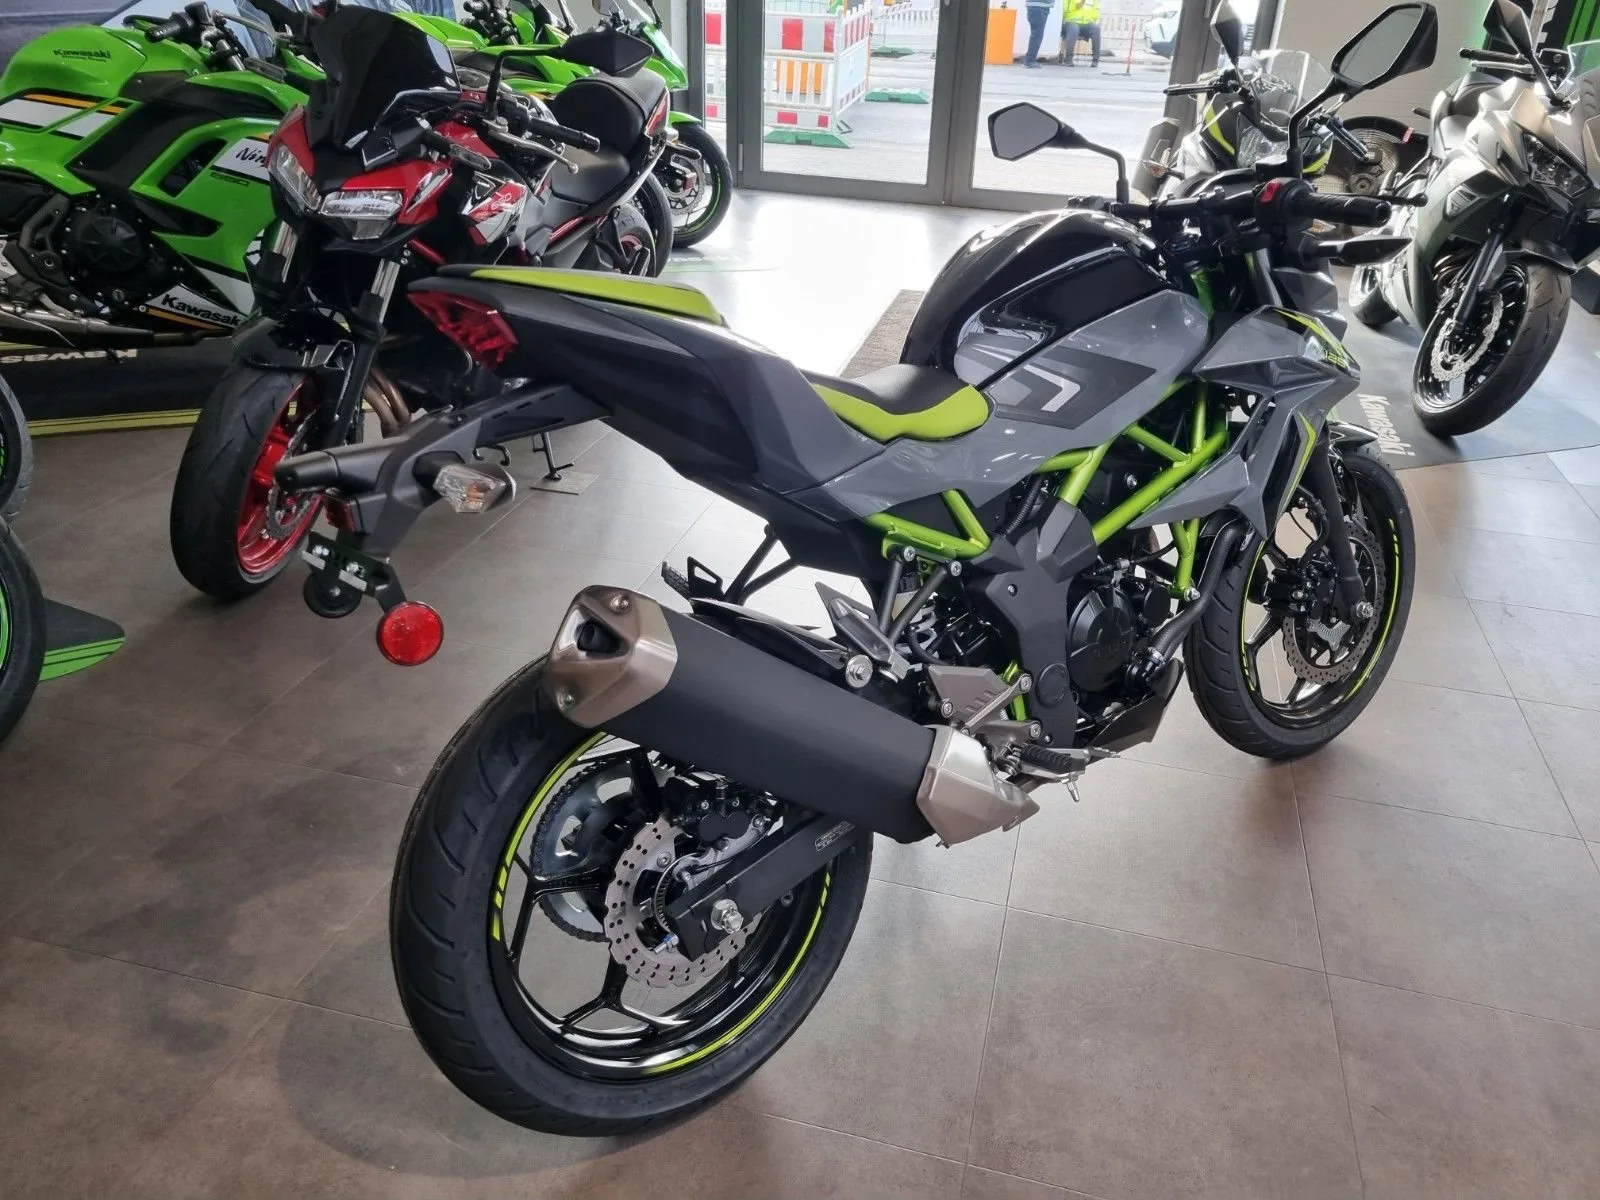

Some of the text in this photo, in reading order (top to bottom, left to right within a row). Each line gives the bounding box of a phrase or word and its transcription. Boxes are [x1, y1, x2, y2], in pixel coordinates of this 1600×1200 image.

[235, 147, 268, 168] Nin
[1325, 350, 1347, 368] 125
[1356, 393, 1416, 456] Kawasaki
